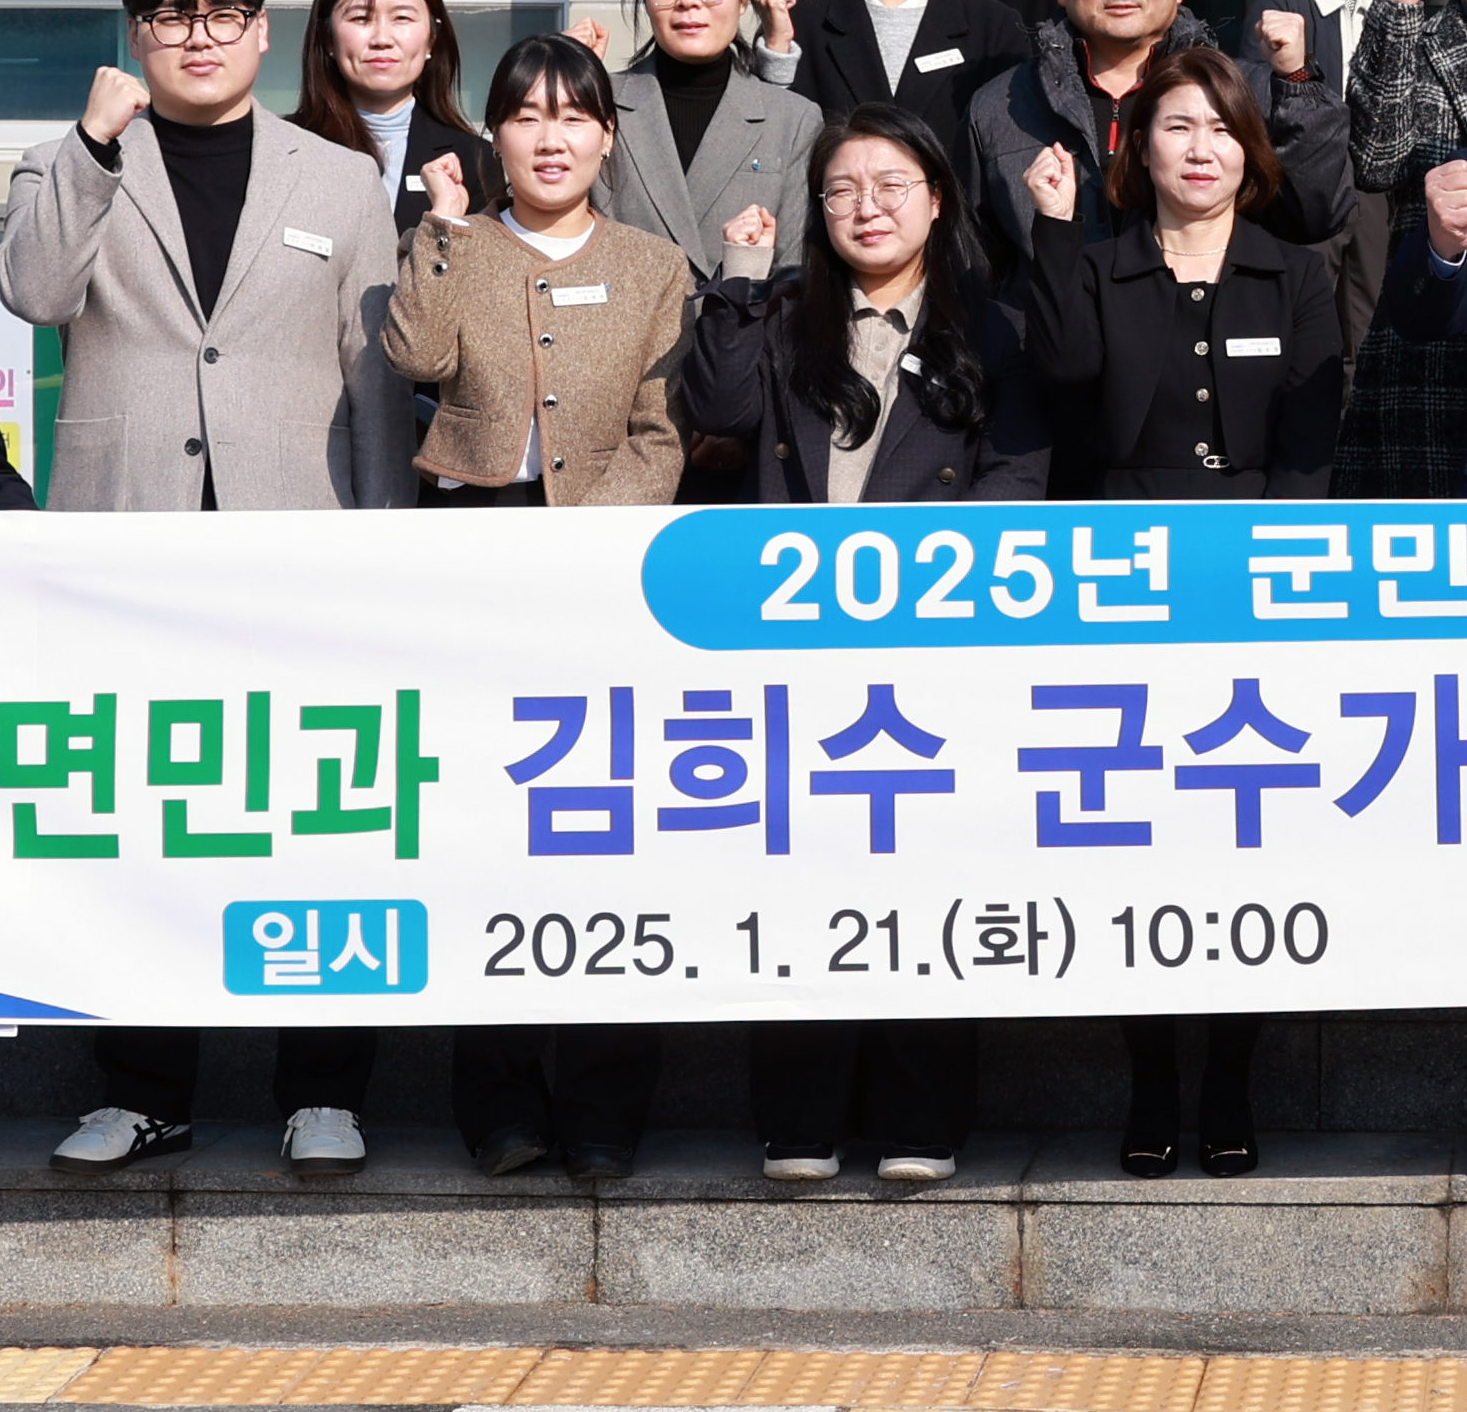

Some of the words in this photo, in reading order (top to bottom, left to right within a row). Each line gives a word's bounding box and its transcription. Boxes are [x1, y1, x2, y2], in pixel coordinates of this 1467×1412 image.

[760, 526, 1170, 623] 2025년
[504, 683, 957, 858] 김희수
[251, 908, 399, 986] 일시
[484, 912, 699, 979] 2025.
[735, 911, 791, 977] 1.
[827, 896, 1077, 981] 21.(화)
[1110, 901, 1330, 969] 10:00
